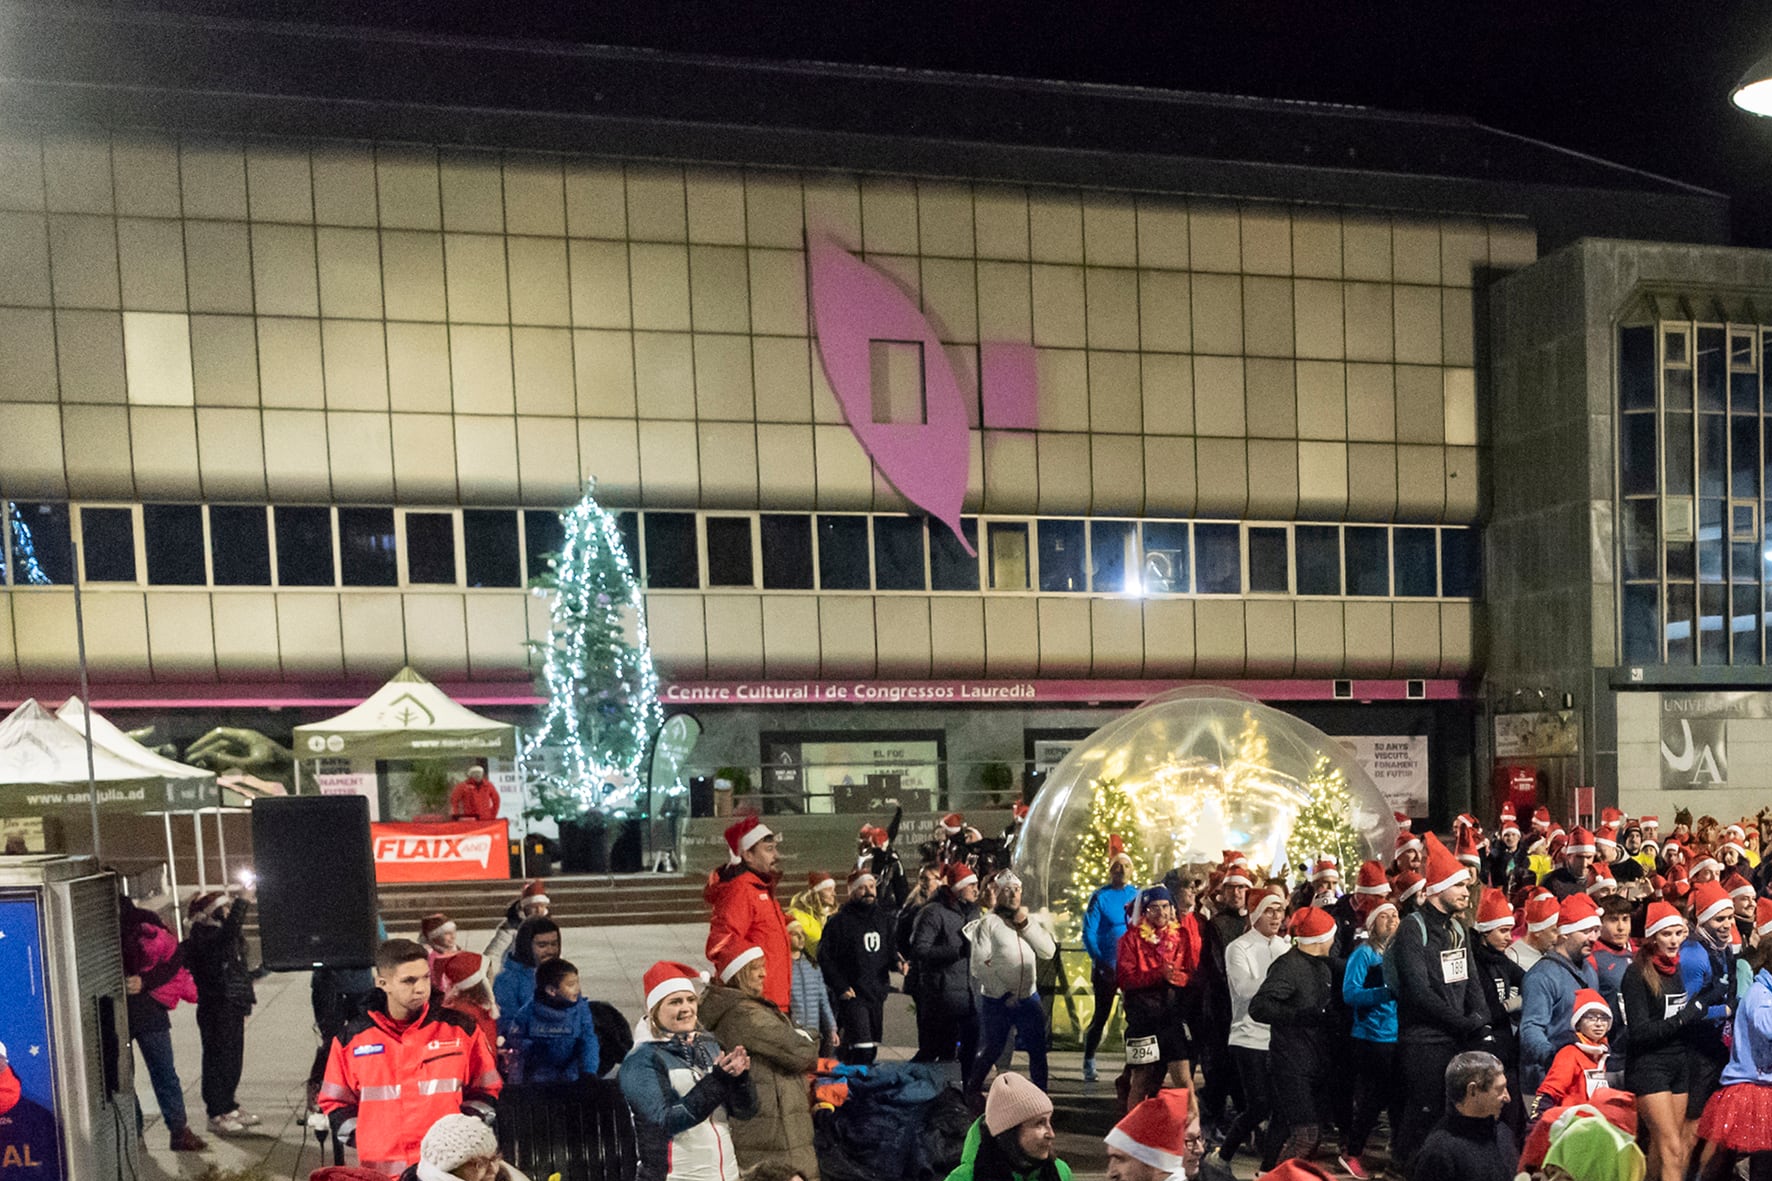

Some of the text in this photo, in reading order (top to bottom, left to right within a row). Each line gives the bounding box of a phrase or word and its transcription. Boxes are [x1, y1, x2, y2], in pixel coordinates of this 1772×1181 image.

[667, 683, 1037, 702] Centre Cultural i de Congressos Lauredià
[26, 789, 145, 805] www.sanjulia.ad
[377, 838, 464, 860] FLAIX
[1131, 1046, 1154, 1060] 294
